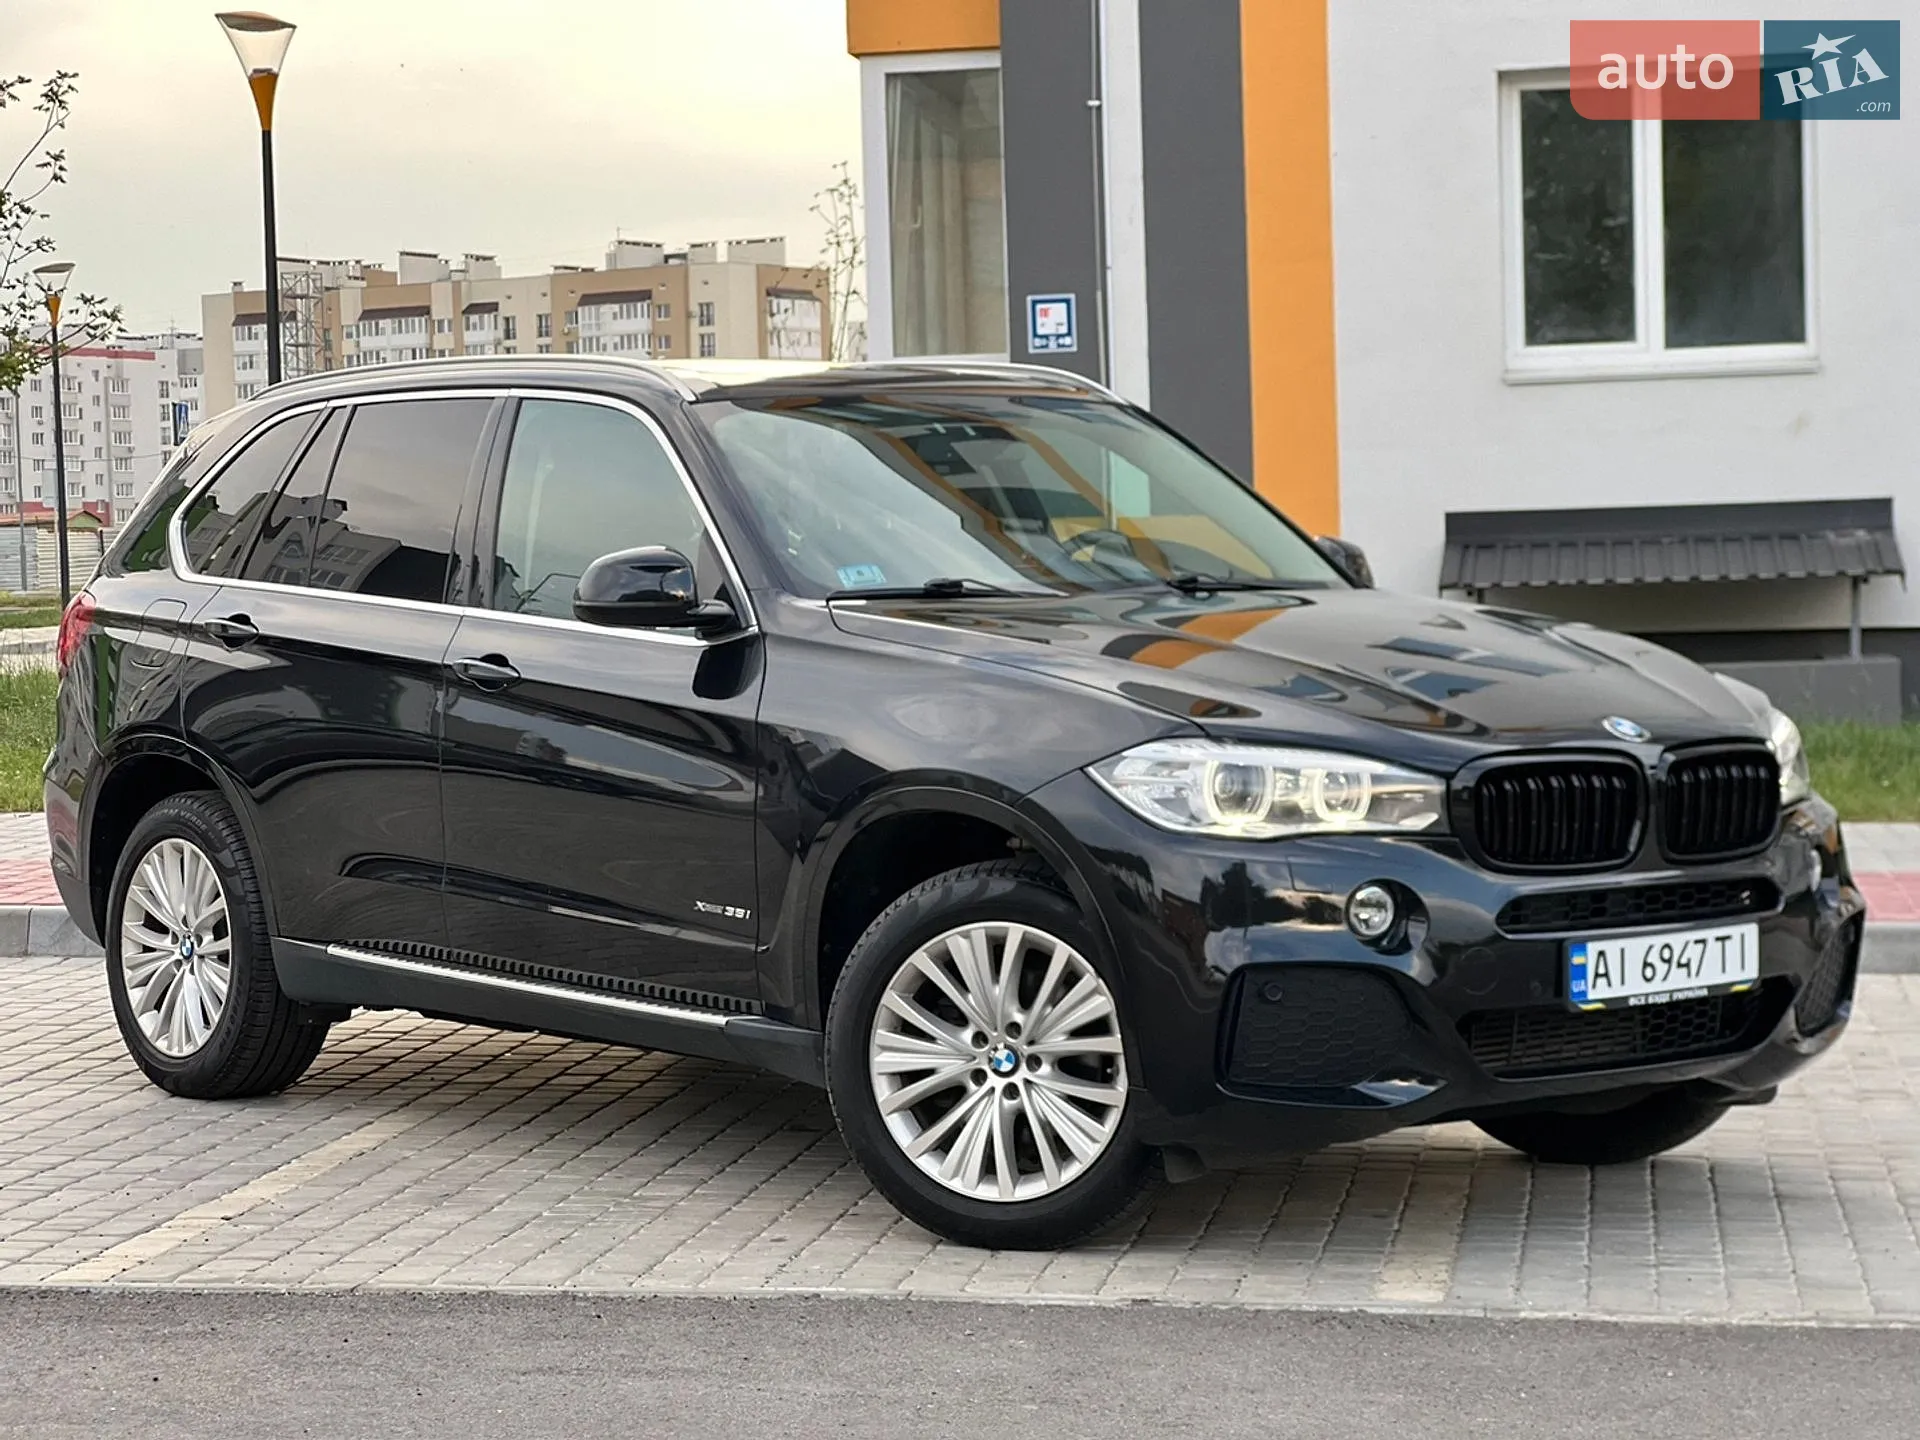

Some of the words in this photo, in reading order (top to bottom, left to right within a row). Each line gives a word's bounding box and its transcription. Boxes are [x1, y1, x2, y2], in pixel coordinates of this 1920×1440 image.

[1592, 948, 1625, 990] AI
[1641, 939, 1708, 983] 6947
[1715, 932, 1746, 975] TI
